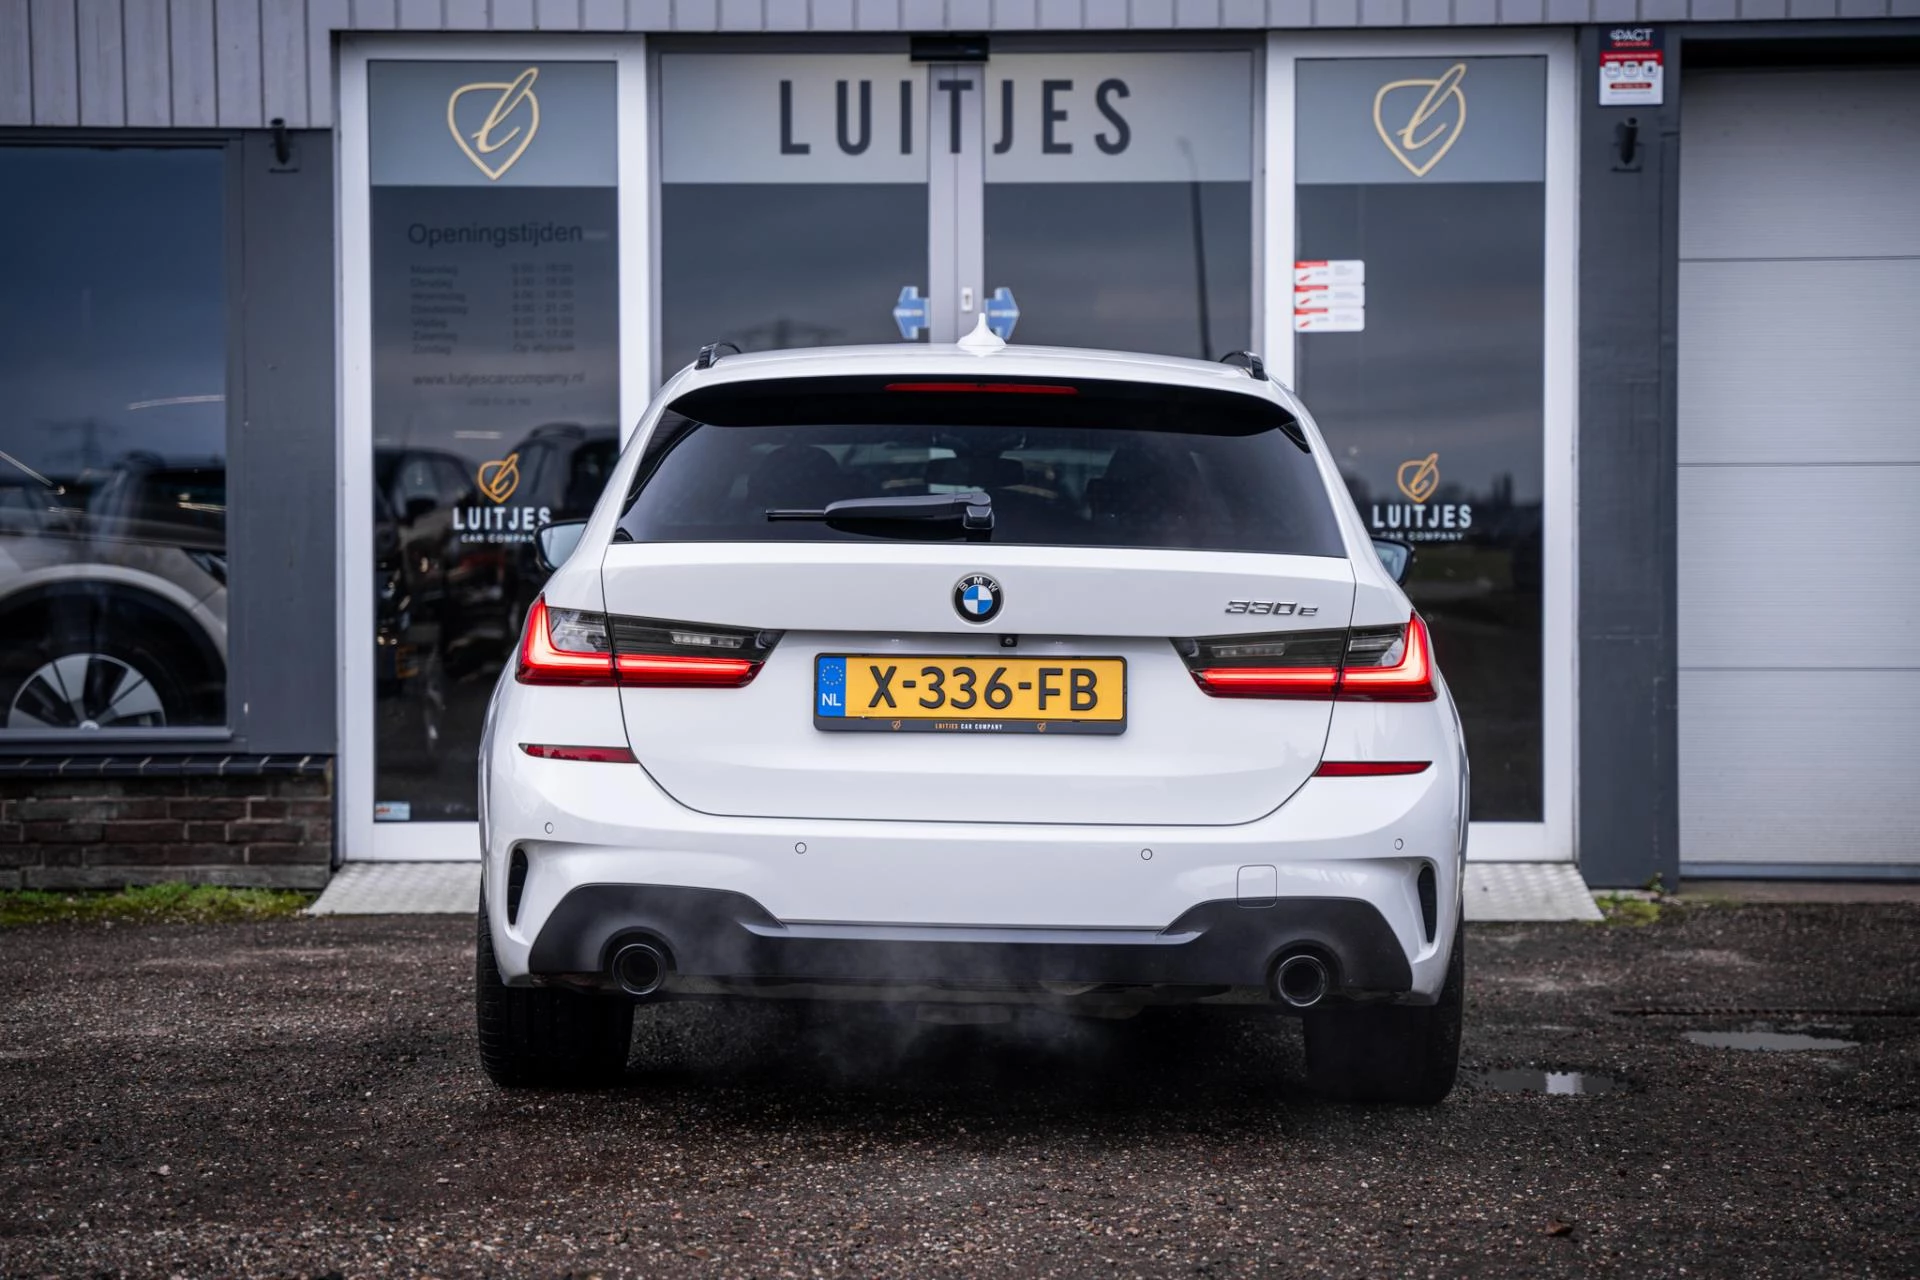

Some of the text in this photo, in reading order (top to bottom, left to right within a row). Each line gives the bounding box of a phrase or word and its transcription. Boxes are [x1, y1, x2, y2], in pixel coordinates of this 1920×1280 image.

[779, 78, 1132, 155] LUITJES
[407, 221, 583, 247] Openingstijden
[452, 506, 551, 530] LUITJES
[1372, 504, 1472, 528] LUITJES
[461, 533, 535, 543] CAR COMPAN
[1407, 531, 1464, 540] COMPANY
[959, 576, 999, 593] BMW
[822, 692, 841, 706] NL
[868, 665, 1099, 711] X-336-FB
